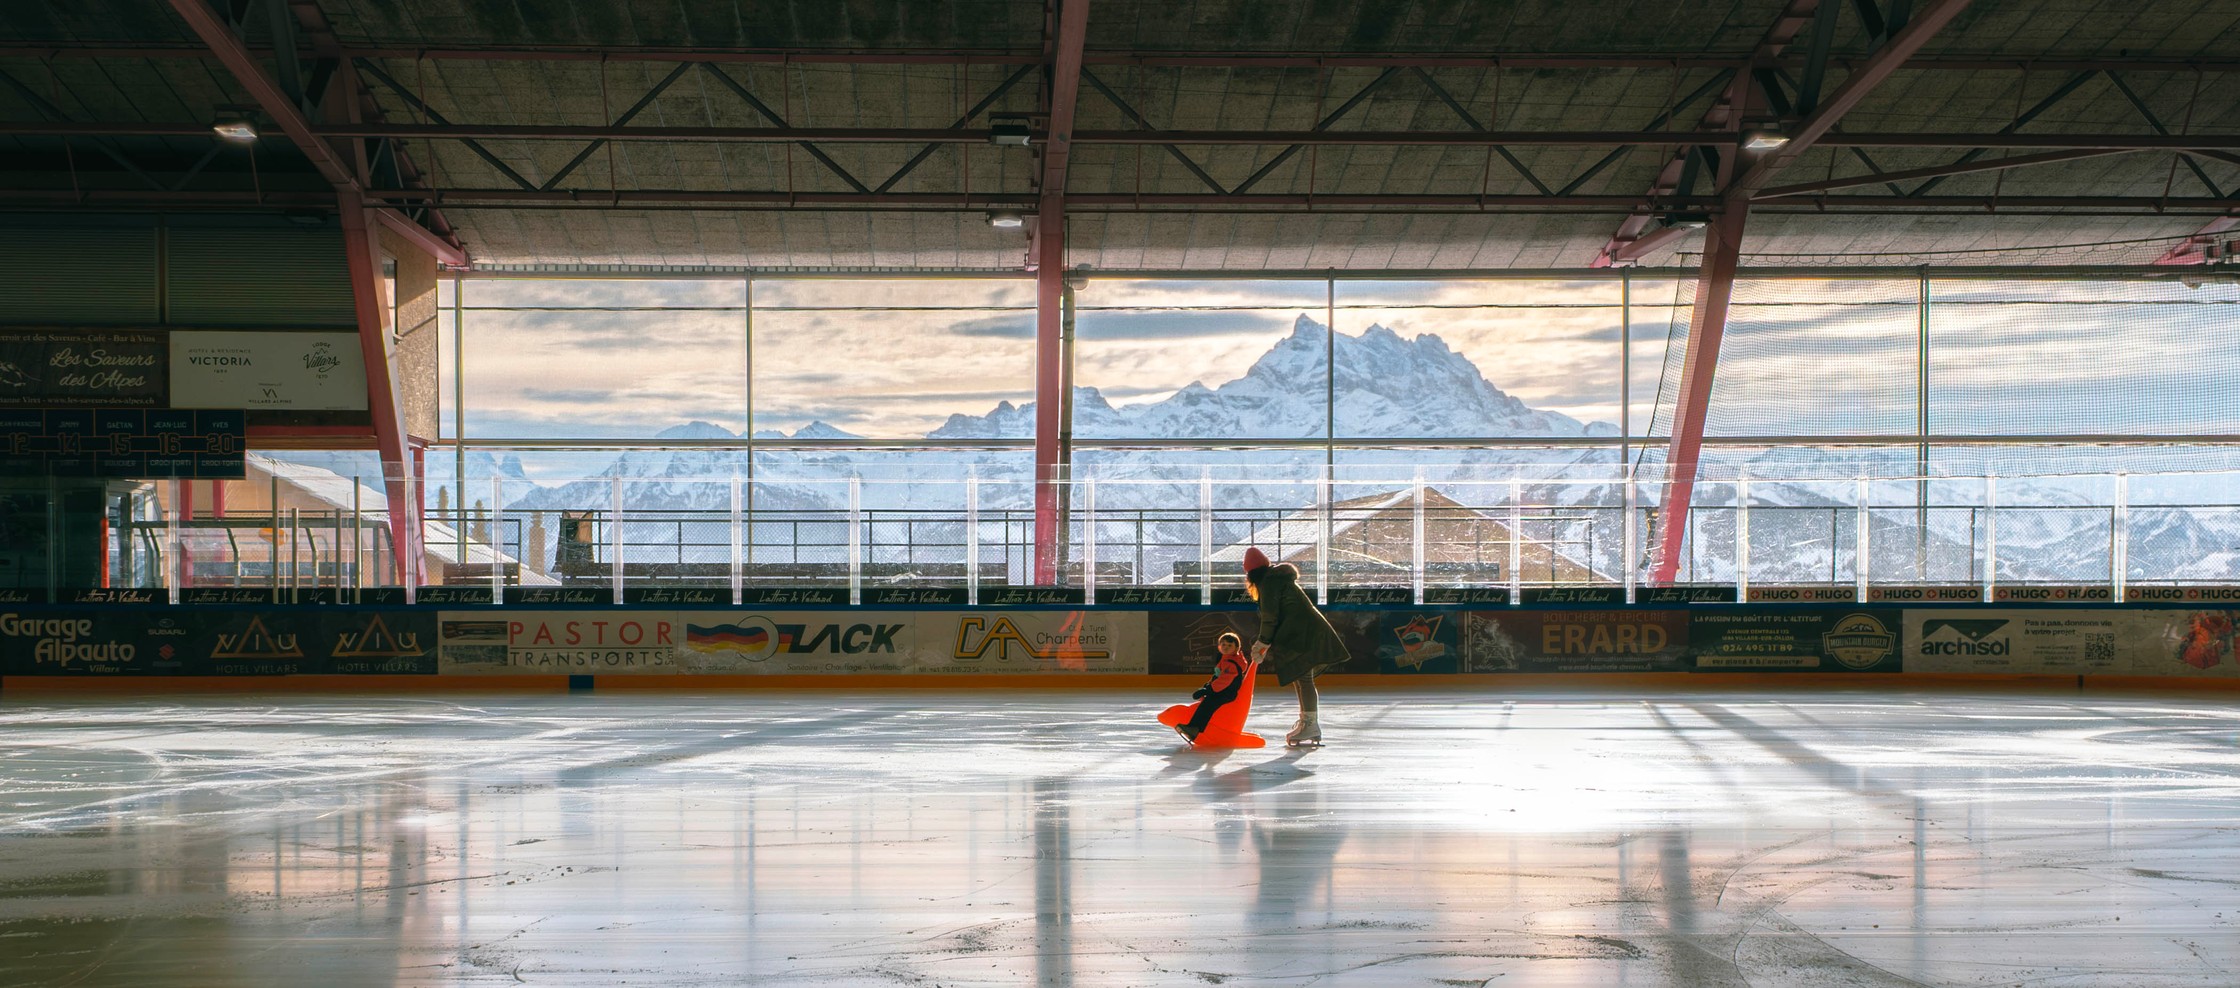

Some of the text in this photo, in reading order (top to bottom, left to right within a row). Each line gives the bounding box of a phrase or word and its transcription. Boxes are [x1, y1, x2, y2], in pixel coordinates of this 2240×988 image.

[33, 333, 47, 342] des
[49, 334, 81, 342] Saveurs
[113, 334, 128, 342] Bar
[137, 334, 155, 342] Vins
[312, 341, 331, 349] LODGE
[49, 347, 156, 367] Les Saveurs
[189, 356, 252, 366] VICTORIA
[303, 347, 341, 373] Villars
[59, 369, 147, 390] des Alpes
[9, 432, 31, 455] 12
[57, 432, 81, 455] 14
[109, 432, 131, 456] 15
[158, 432, 181, 455] 16
[206, 433, 234, 455] 20
[1762, 589, 1852, 600] HUGO HUGO
[1884, 589, 1978, 600] HUGO HUGO
[2011, 589, 2108, 600] HUGO HUGO
[2142, 589, 2240, 600] HUGO HUGO
[1743, 613, 1762, 622] GOÛT
[2024, 619, 2038, 627] Pas
[2047, 620, 2063, 629] pas,
[2064, 619, 2099, 627] donnons
[0, 612, 93, 642] Garage
[509, 621, 673, 645] PASTOR
[2053, 629, 2076, 637] projet
[788, 623, 905, 654] LACK
[1036, 632, 1107, 646] Charpente
[1543, 624, 1667, 655] ERARD
[34, 638, 137, 668] Alpauto
[1722, 644, 1793, 652] 024 495 11 89
[1921, 638, 2010, 655] archisol
[509, 652, 663, 667] TRANSPORTS
[89, 664, 120, 673] Villars
[215, 664, 298, 673] HOTEL VILLARS
[337, 663, 418, 673] HOTEL VILLARS
